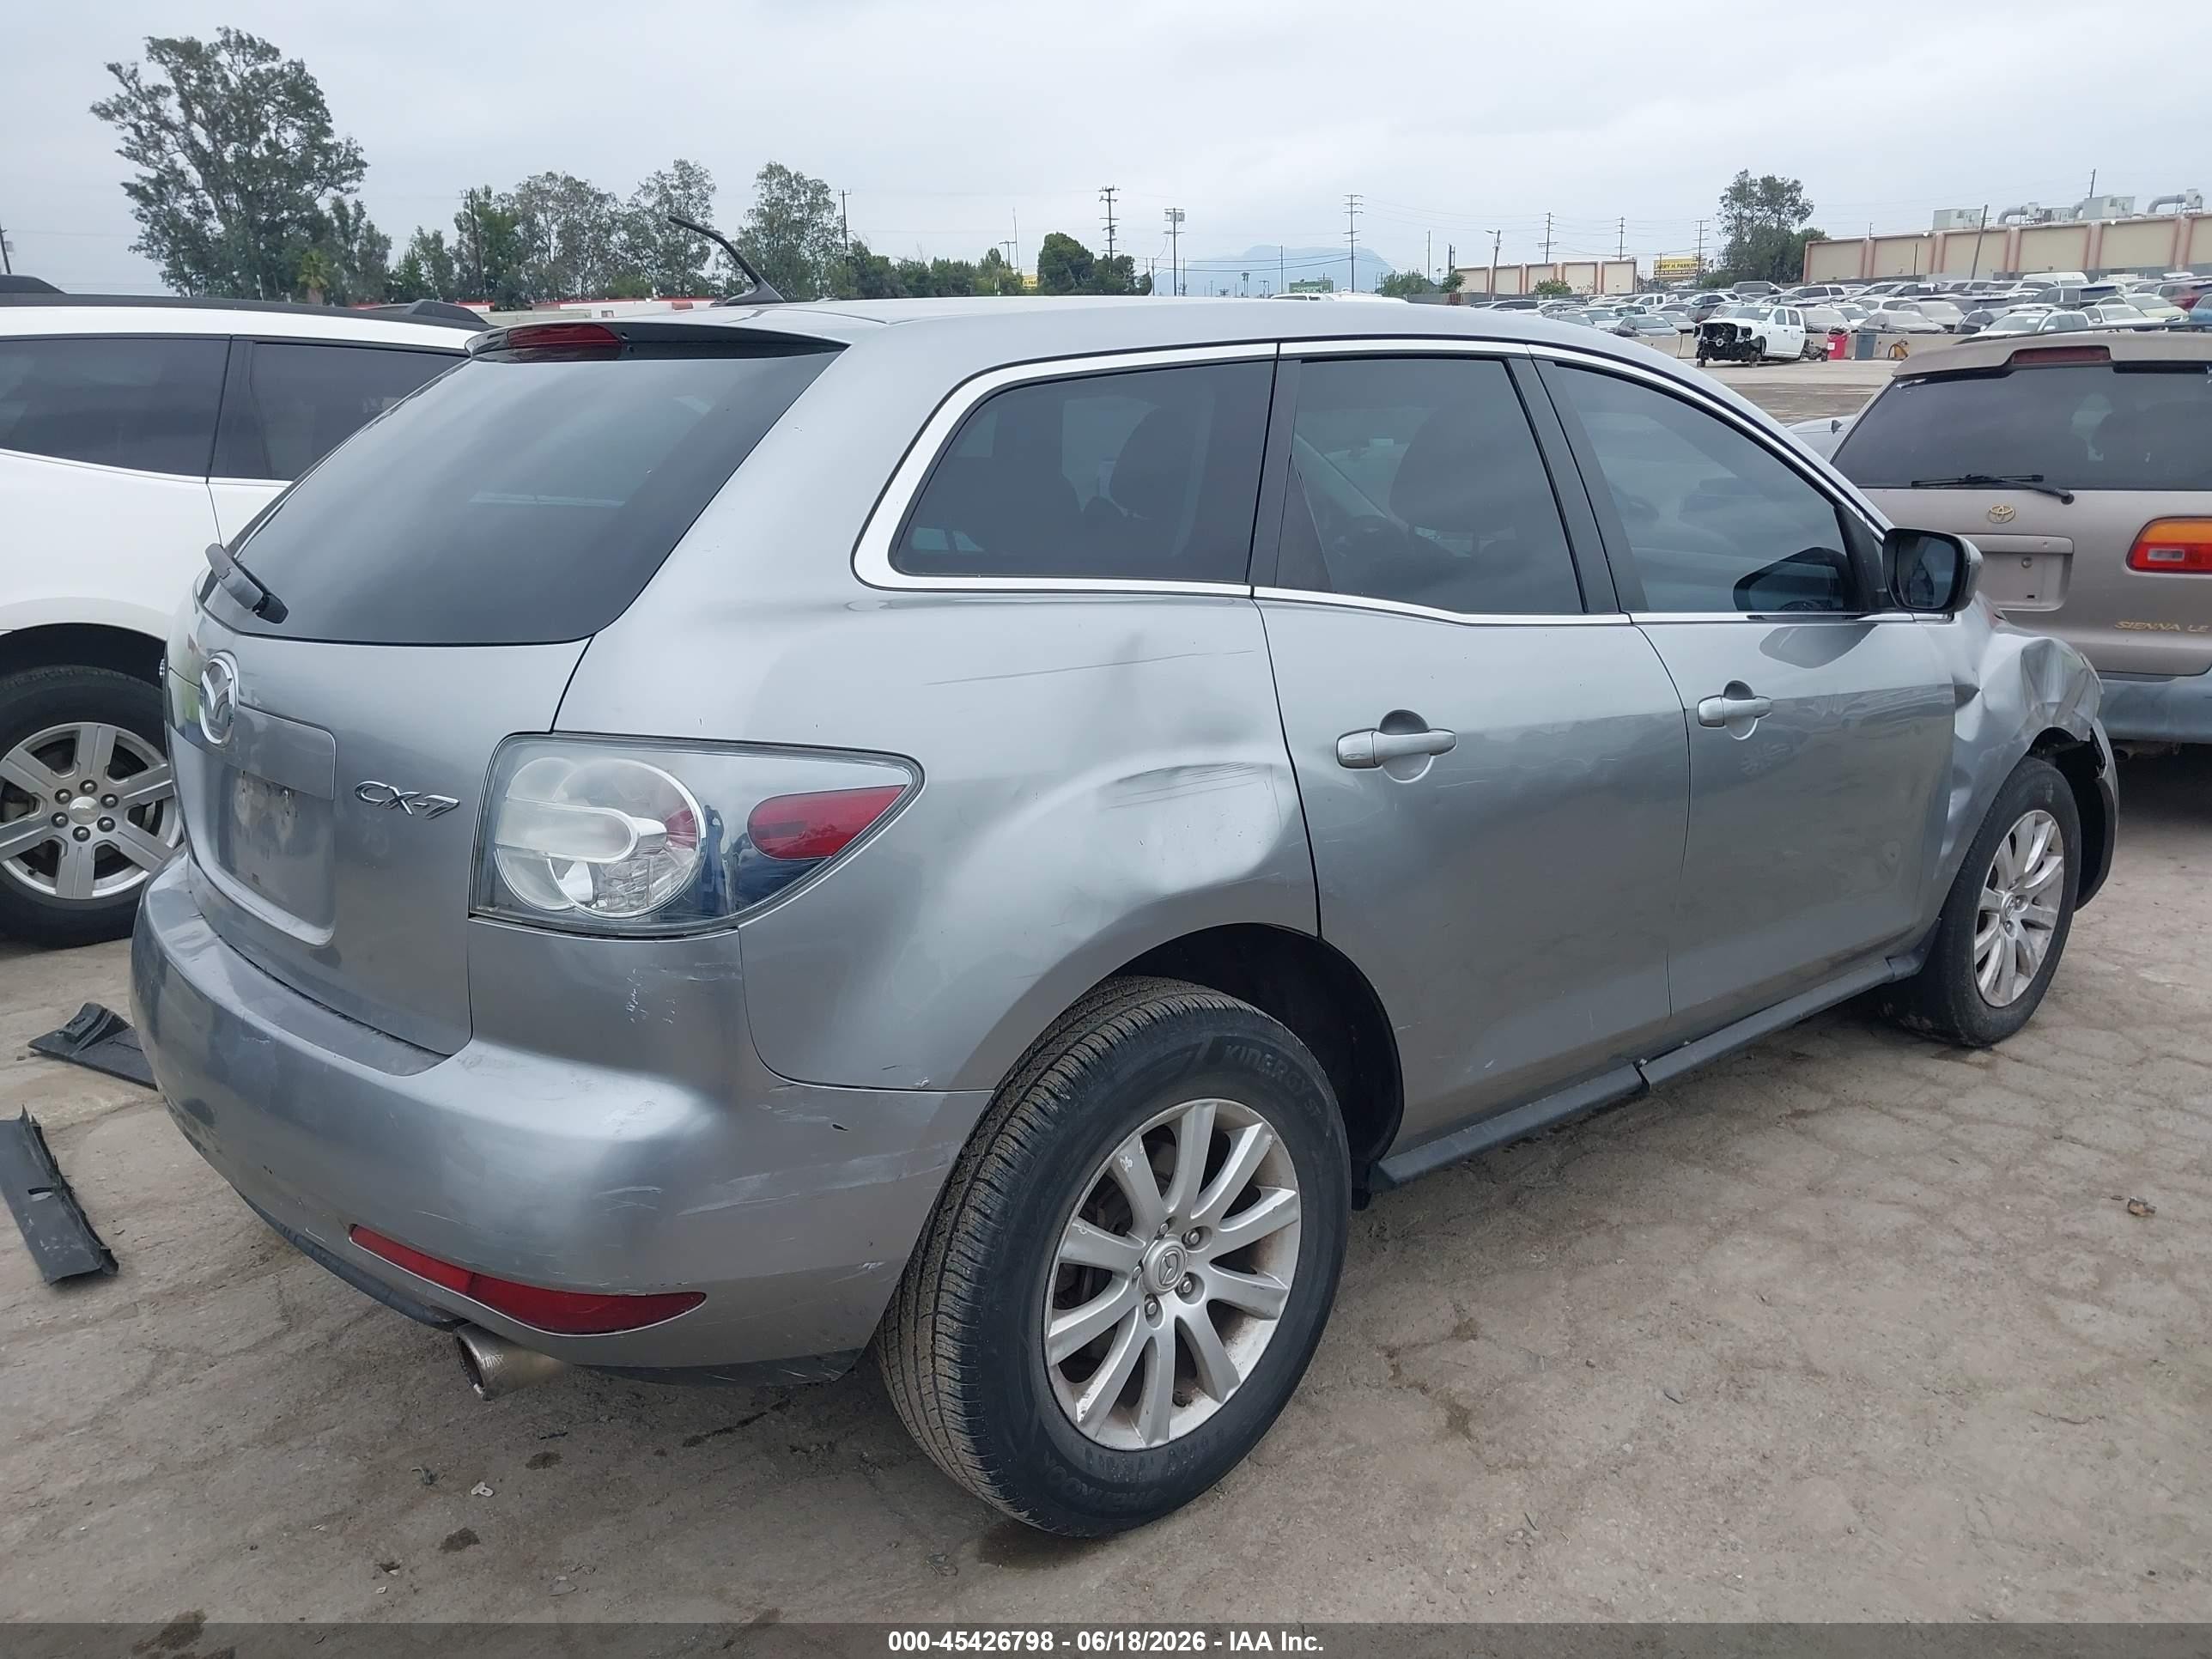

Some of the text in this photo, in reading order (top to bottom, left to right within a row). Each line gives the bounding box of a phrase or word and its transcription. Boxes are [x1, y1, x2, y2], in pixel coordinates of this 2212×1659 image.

[2114, 621, 2211, 633] SIENNA LE
[355, 780, 461, 820] CX-7
[1221, 1043, 1312, 1097] KINERGY
